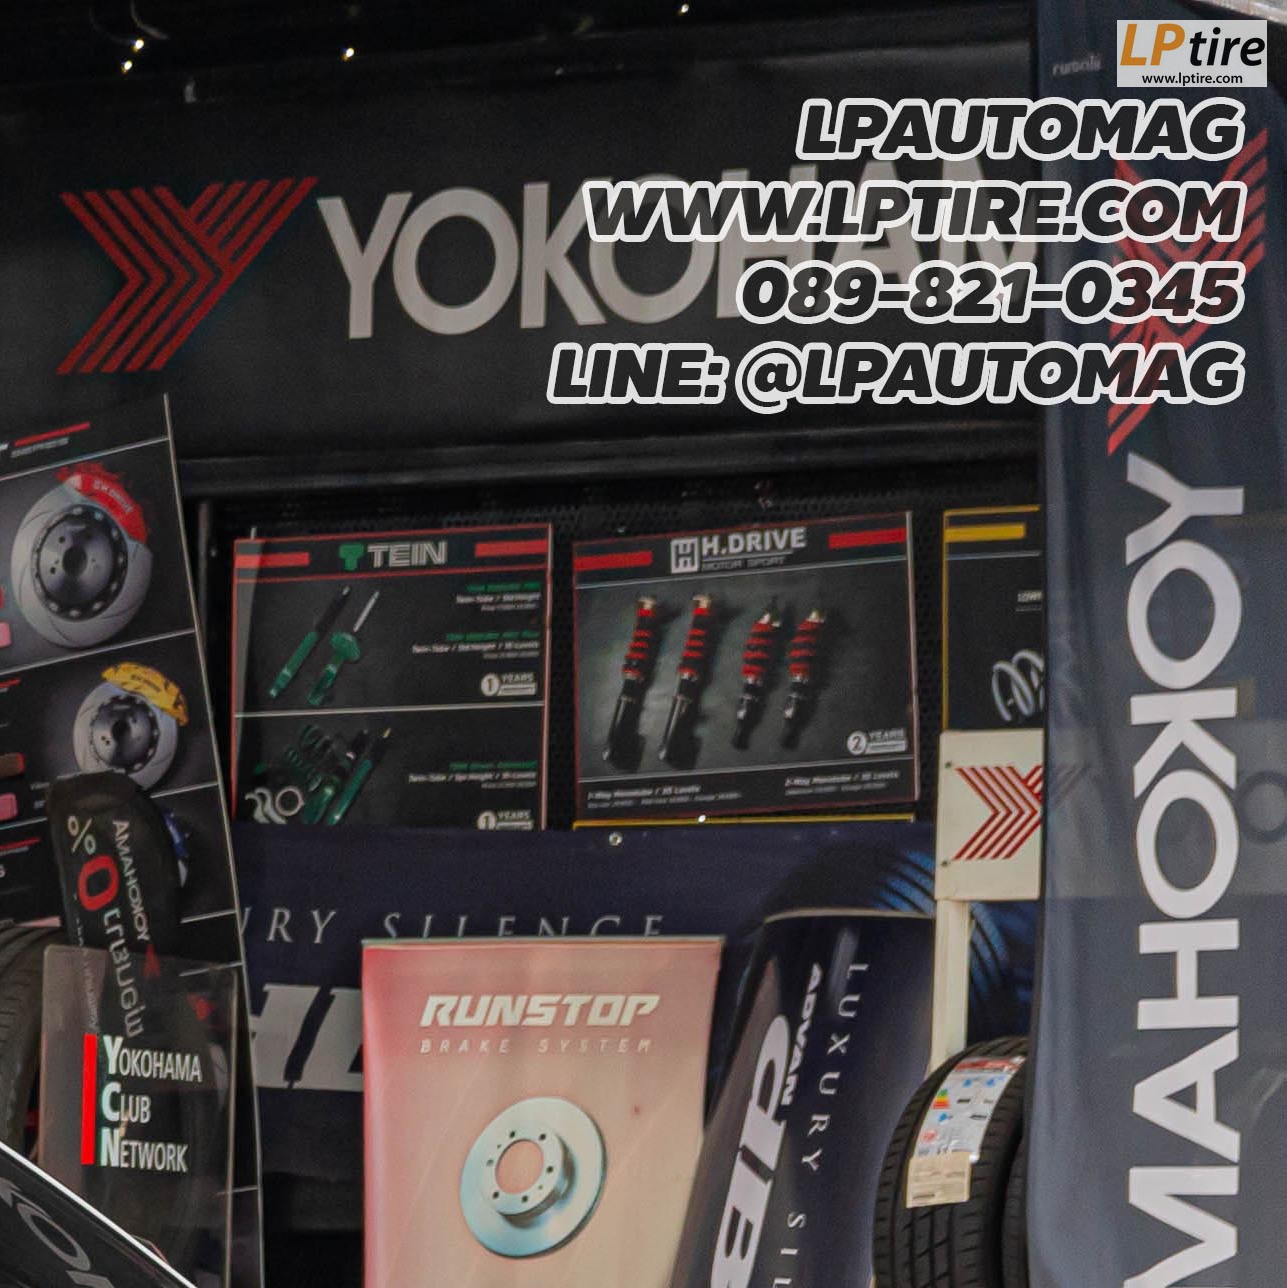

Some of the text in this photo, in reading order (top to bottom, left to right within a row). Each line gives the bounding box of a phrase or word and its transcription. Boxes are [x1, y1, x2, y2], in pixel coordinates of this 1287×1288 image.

[367, 540, 448, 569] TEIN
[701, 526, 808, 556] H.DRIVE
[419, 994, 660, 1028] RUNSTOP
[419, 1038, 653, 1054] BRAKE SYSTEM
[781, 963, 822, 1106] ADVAN
[102, 1034, 203, 1082] YOKOHAMA
[800, 962, 869, 1172] LUXURY
[102, 1081, 151, 1124] CLUB
[100, 1127, 190, 1173] NETWORK
